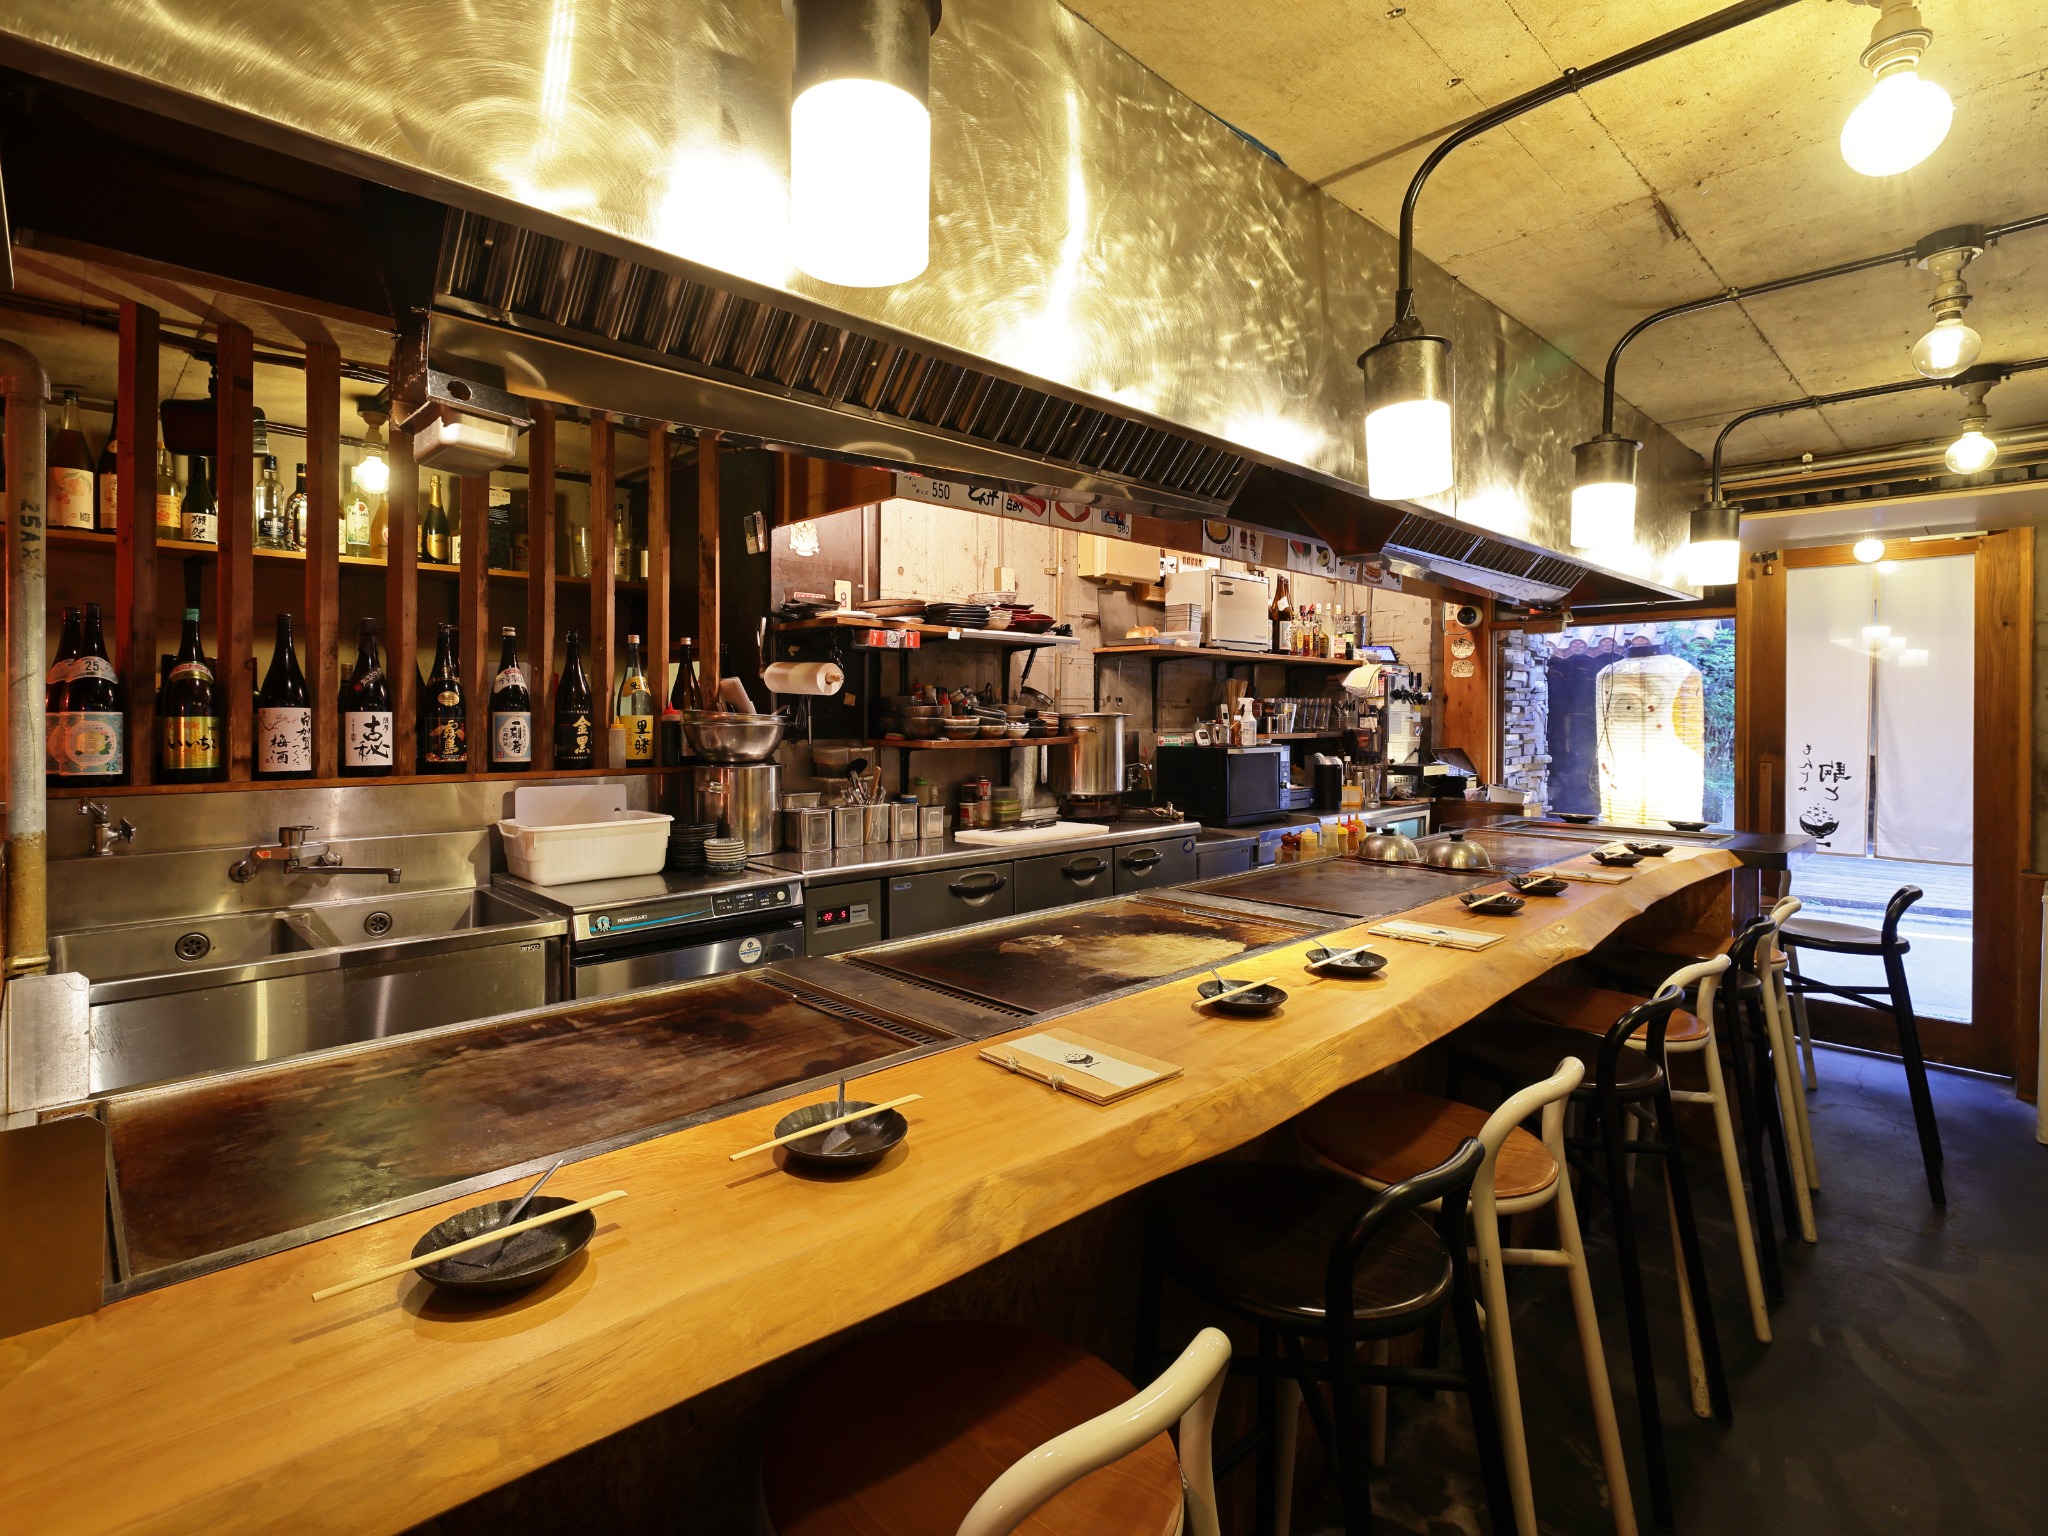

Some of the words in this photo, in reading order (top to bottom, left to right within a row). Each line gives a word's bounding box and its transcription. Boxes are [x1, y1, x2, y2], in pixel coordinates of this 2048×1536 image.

[932, 482, 950, 500] 550
[85, 660, 100, 672] 25
[168, 735, 217, 751] いいちこ
[572, 715, 592, 755] 金黒
[267, 733, 291, 765] 梅酒
[105, 762, 116, 772] 25
